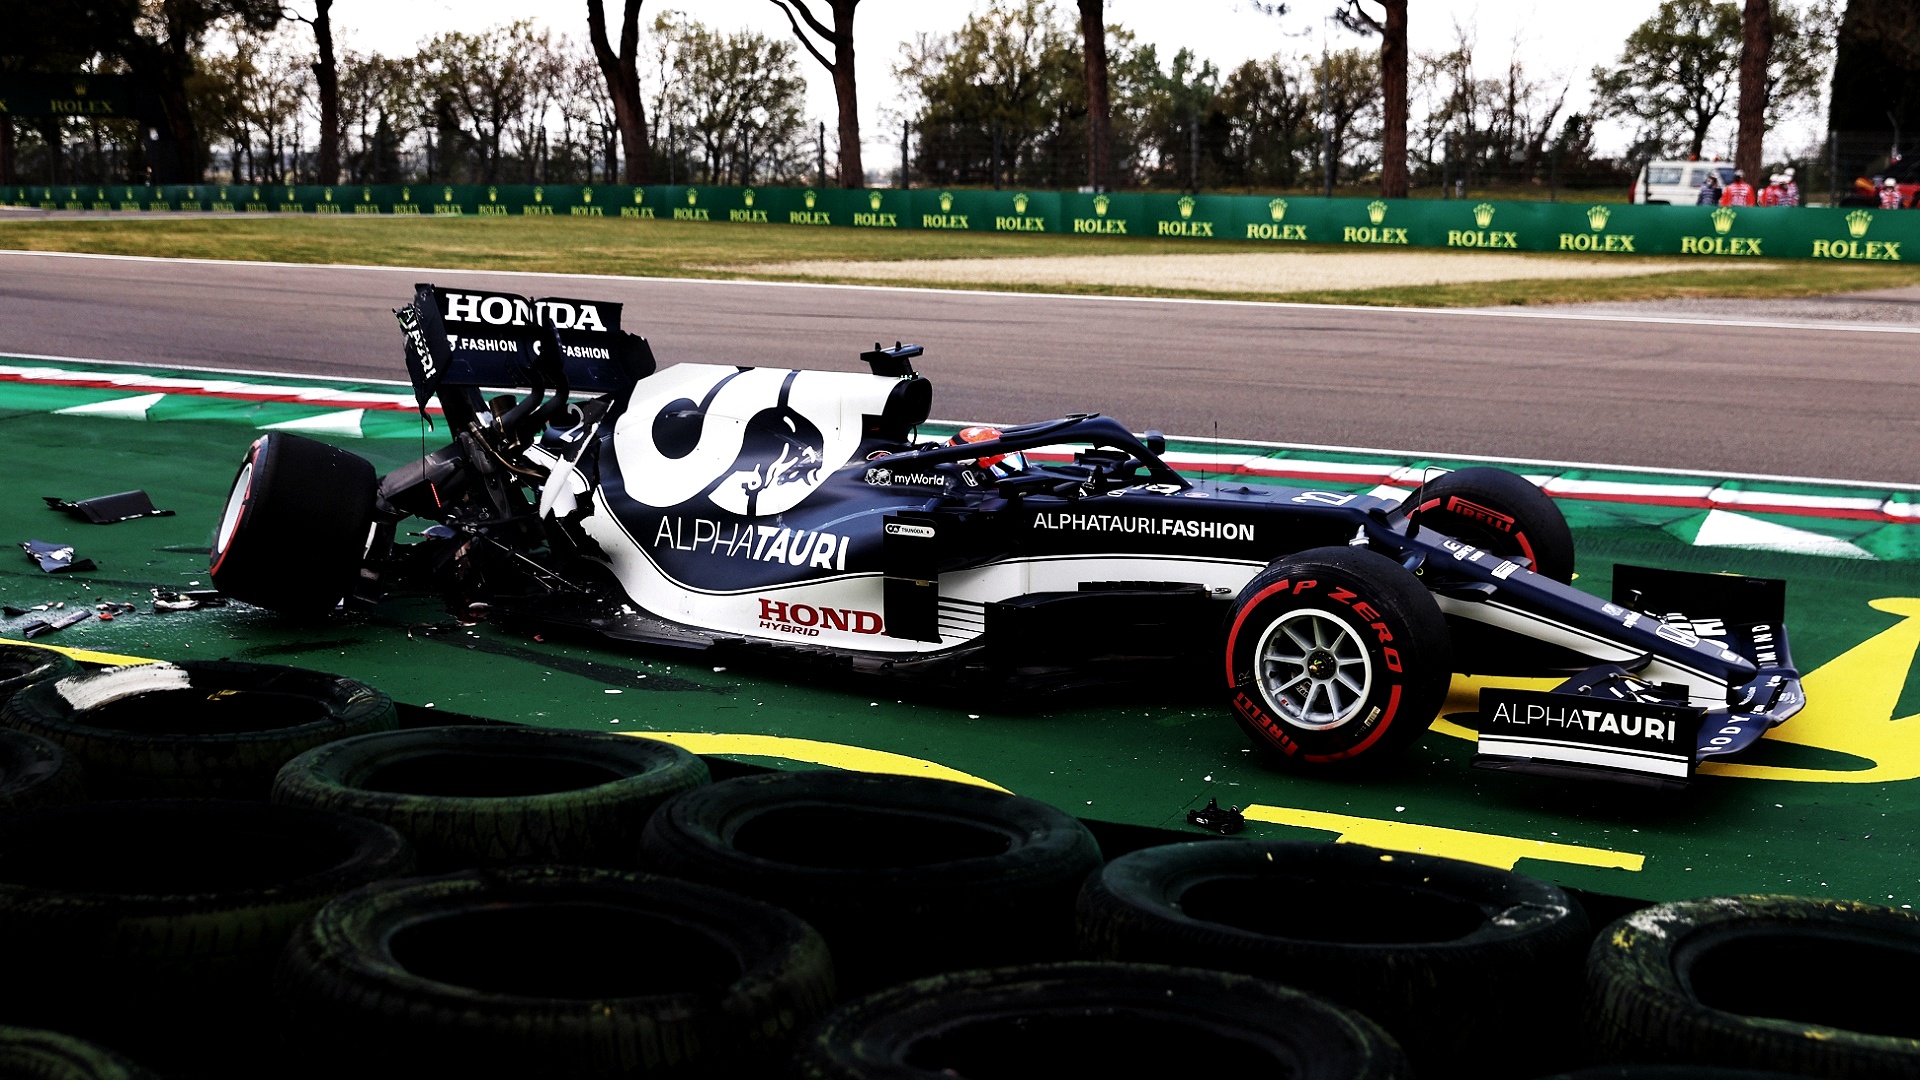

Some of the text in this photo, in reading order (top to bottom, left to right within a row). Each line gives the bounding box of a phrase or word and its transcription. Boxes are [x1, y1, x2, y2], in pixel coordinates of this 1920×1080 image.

[51, 100, 112, 113] ROLEX
[478, 205, 508, 216] ROLEX
[523, 205, 554, 215] ROLEX
[571, 206, 603, 217] ROLEX
[620, 207, 655, 219] ROLEX
[674, 208, 709, 221] ROLEX
[730, 209, 768, 223] ROLEX
[790, 211, 831, 225] ROLEX
[854, 213, 897, 227] ROLEX
[923, 214, 969, 229] ROLEX
[996, 216, 1045, 231] ROLEX
[1073, 218, 1127, 234] ROLEX
[1158, 220, 1213, 237] ROLEX
[1246, 223, 1307, 241] ROLEX
[1343, 226, 1408, 244] ROLEX
[1448, 230, 1518, 248] ROLEX
[1559, 233, 1636, 252] ROLEX
[1681, 236, 1762, 256] ROLEX
[1812, 239, 1901, 261] ROLEX
[444, 293, 608, 332] HONDA
[894, 473, 945, 487] myWorld
[1446, 495, 1515, 532] PIRELLI
[1033, 512, 1255, 542] ALPHATAURI.FASHION
[653, 515, 850, 571] ALPHATAURI
[758, 597, 889, 637] HOND
[759, 620, 820, 637] HYBRID
[1293, 580, 1403, 673] P ZERO
[1233, 692, 1298, 756] PIRELLI
[1493, 702, 1677, 742] ALPHATAURI
